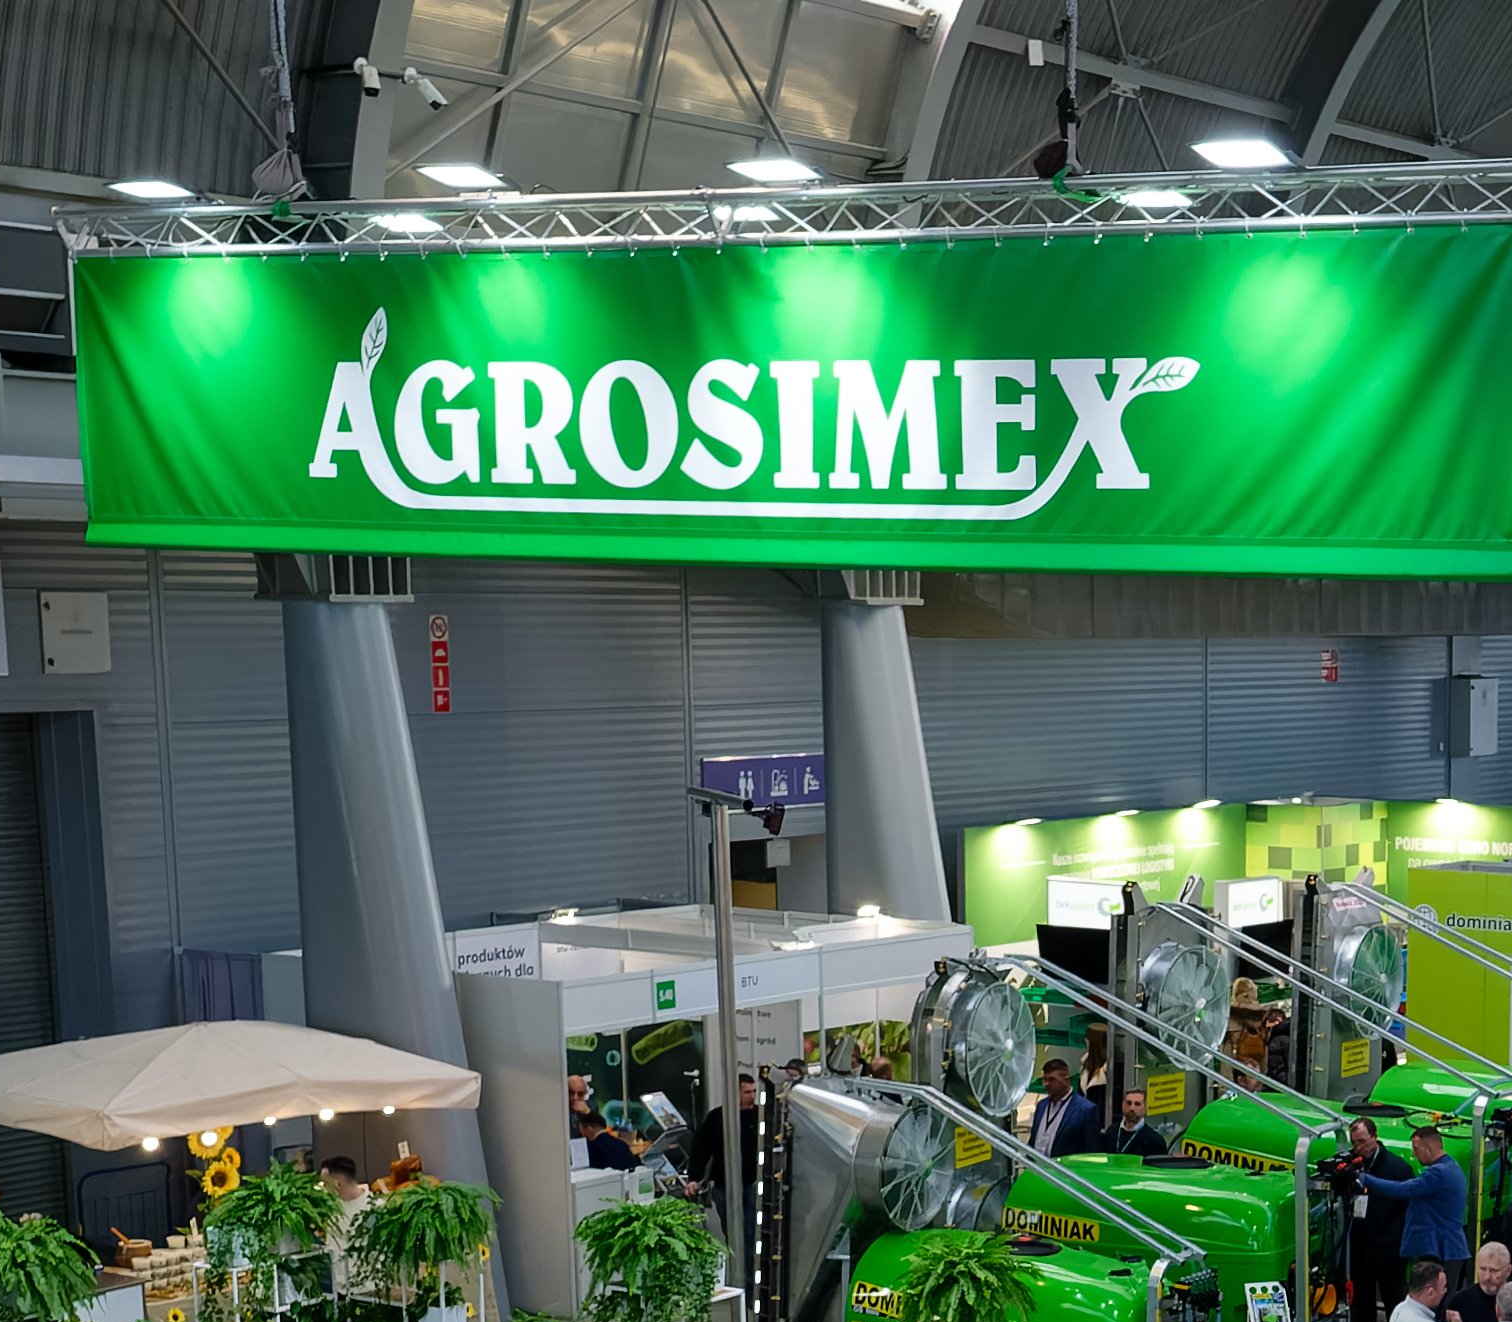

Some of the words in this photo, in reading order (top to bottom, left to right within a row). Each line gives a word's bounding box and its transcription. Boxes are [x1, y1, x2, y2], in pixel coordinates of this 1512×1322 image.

[311, 345, 1178, 519] AGROSIMEX
[458, 946, 525, 968] produktów
[1184, 1141, 1293, 1174] DOMINI
[1005, 1207, 1098, 1242] DOMINIAK
[855, 1281, 902, 1319] DOMI
